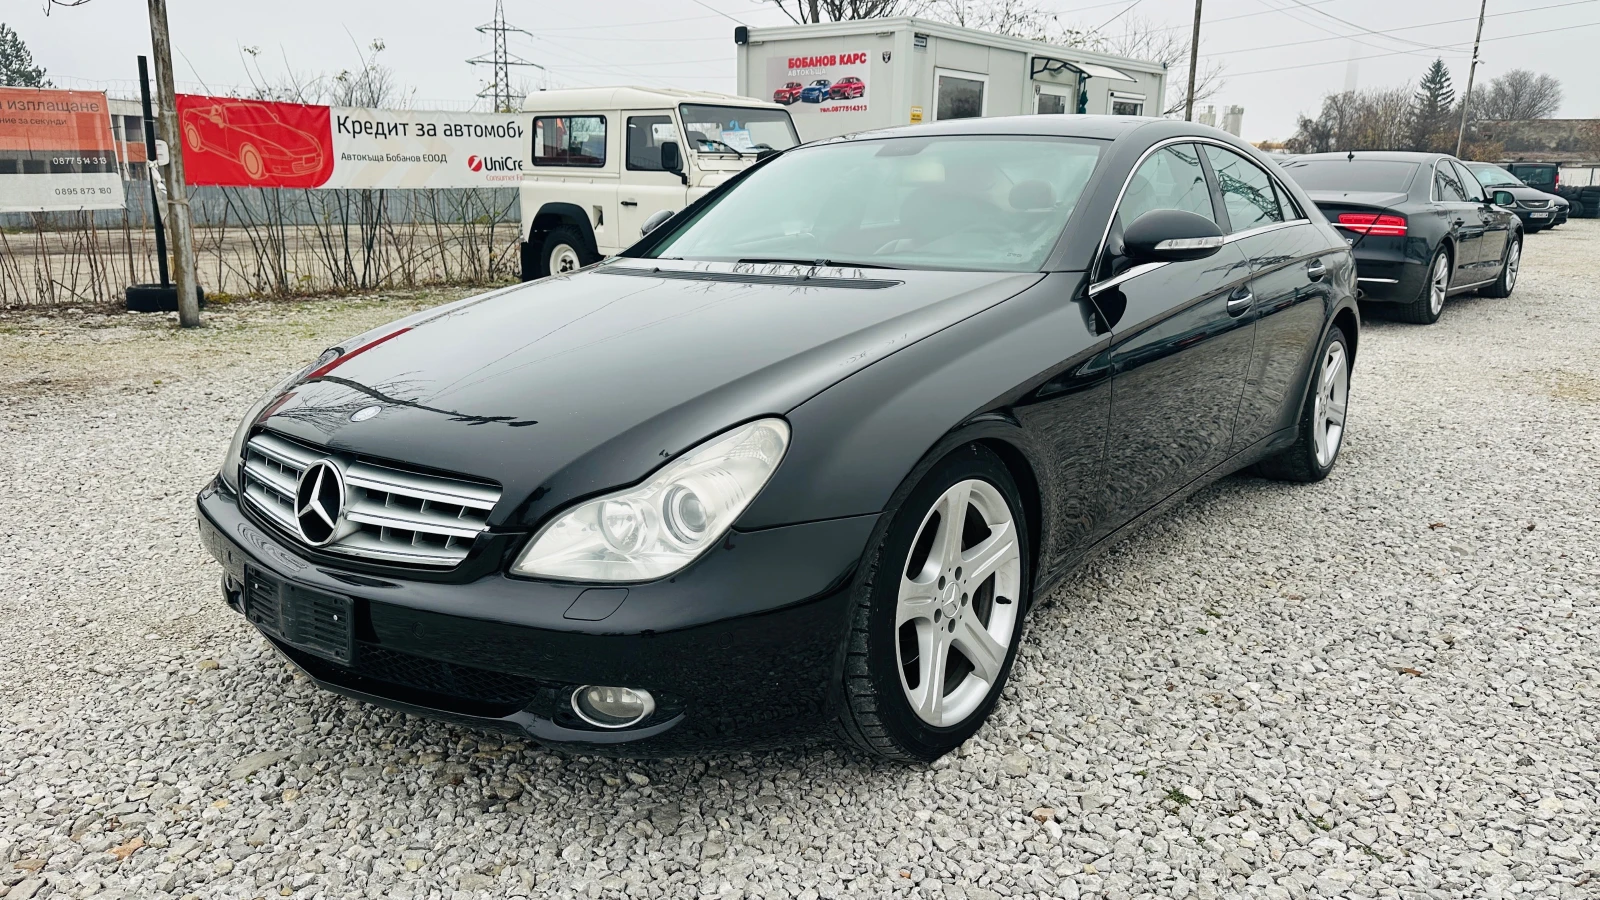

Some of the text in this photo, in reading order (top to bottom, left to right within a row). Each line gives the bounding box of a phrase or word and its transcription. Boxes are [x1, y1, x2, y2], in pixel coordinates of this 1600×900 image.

[788, 52, 867, 69] БОБАНОВ КАРС
[787, 68, 827, 77] АВТОКЪЩА
[7, 100, 100, 114] изплащане
[18, 117, 29, 125] за
[30, 118, 67, 126] секунди
[337, 115, 409, 139] Кредит
[415, 123, 437, 137] за
[52, 157, 107, 165] 0877 514 313
[341, 152, 448, 164] Автокъща Бобанов ЕООД
[486, 174, 515, 182] Consumer
[98, 187, 112, 195] 180
